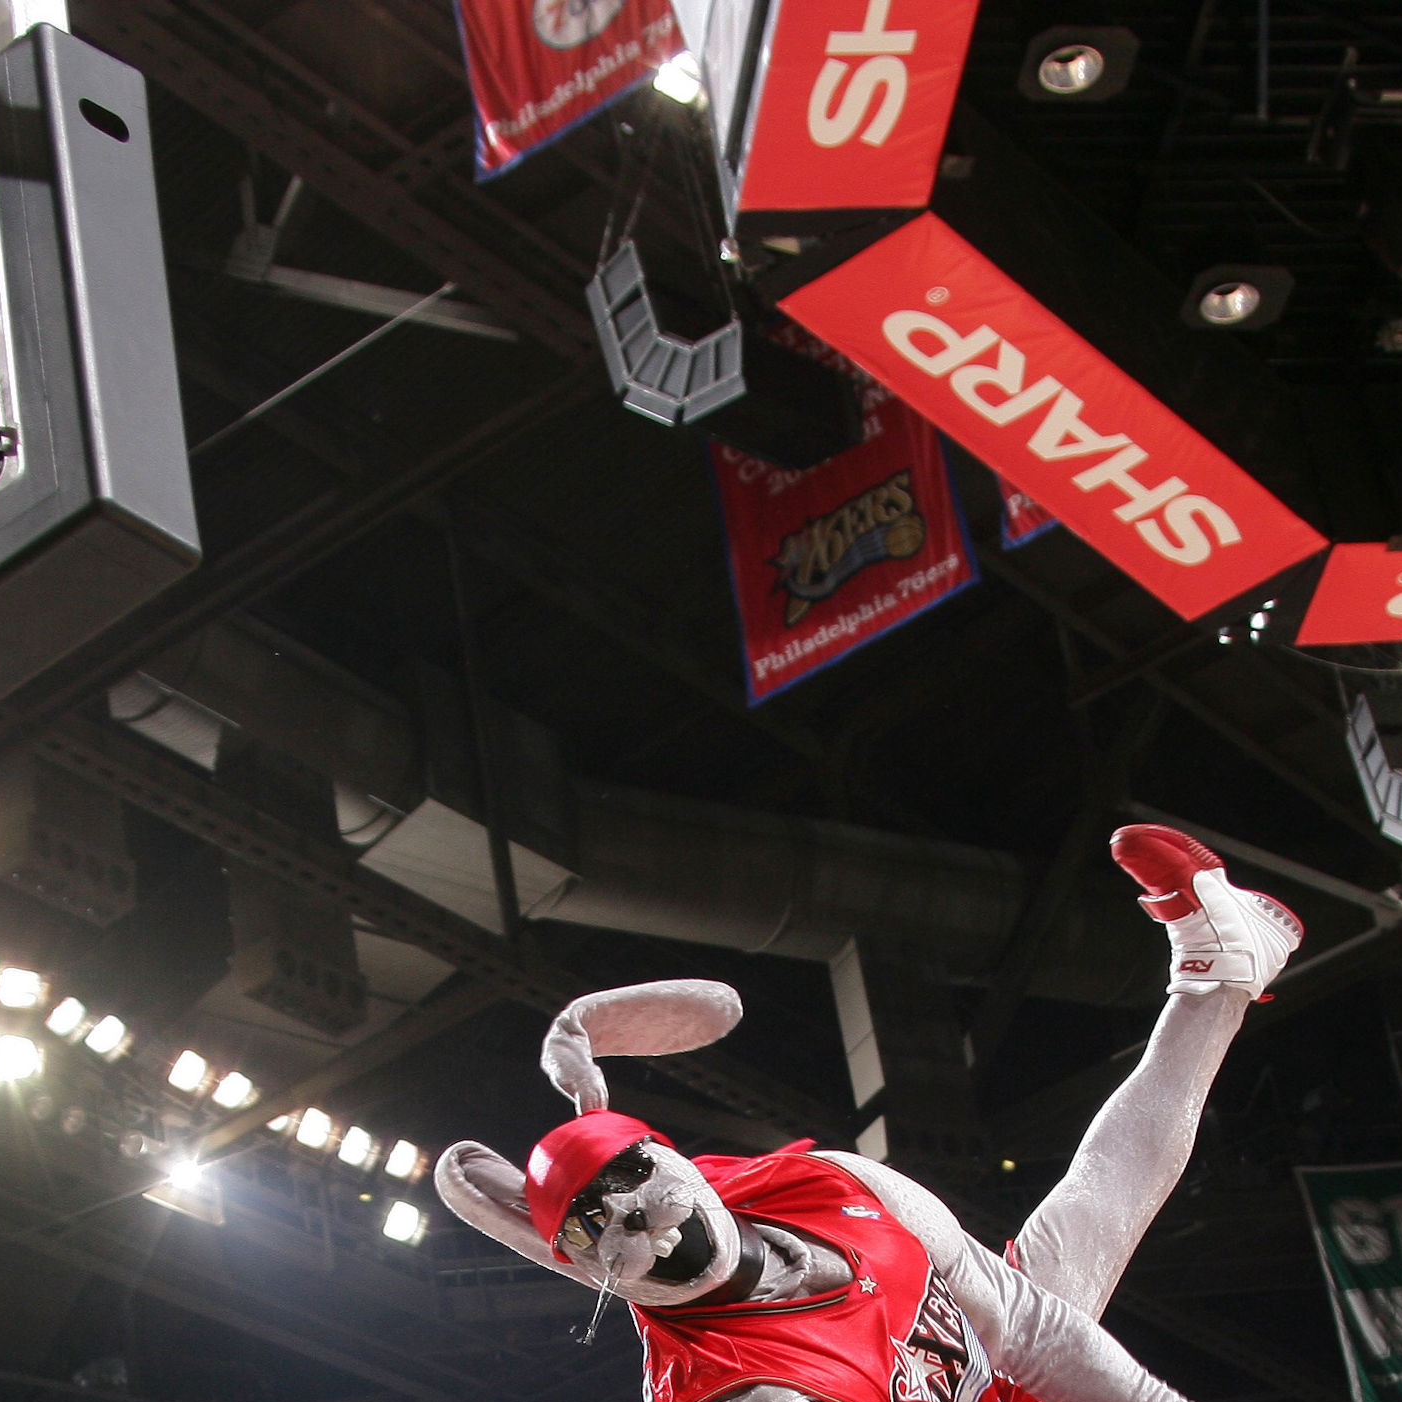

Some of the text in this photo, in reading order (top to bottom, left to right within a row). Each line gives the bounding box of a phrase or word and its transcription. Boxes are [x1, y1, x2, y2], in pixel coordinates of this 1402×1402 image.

[882, 309, 1242, 566] SHARP
[753, 554, 960, 679] Philadelphia 76ers
